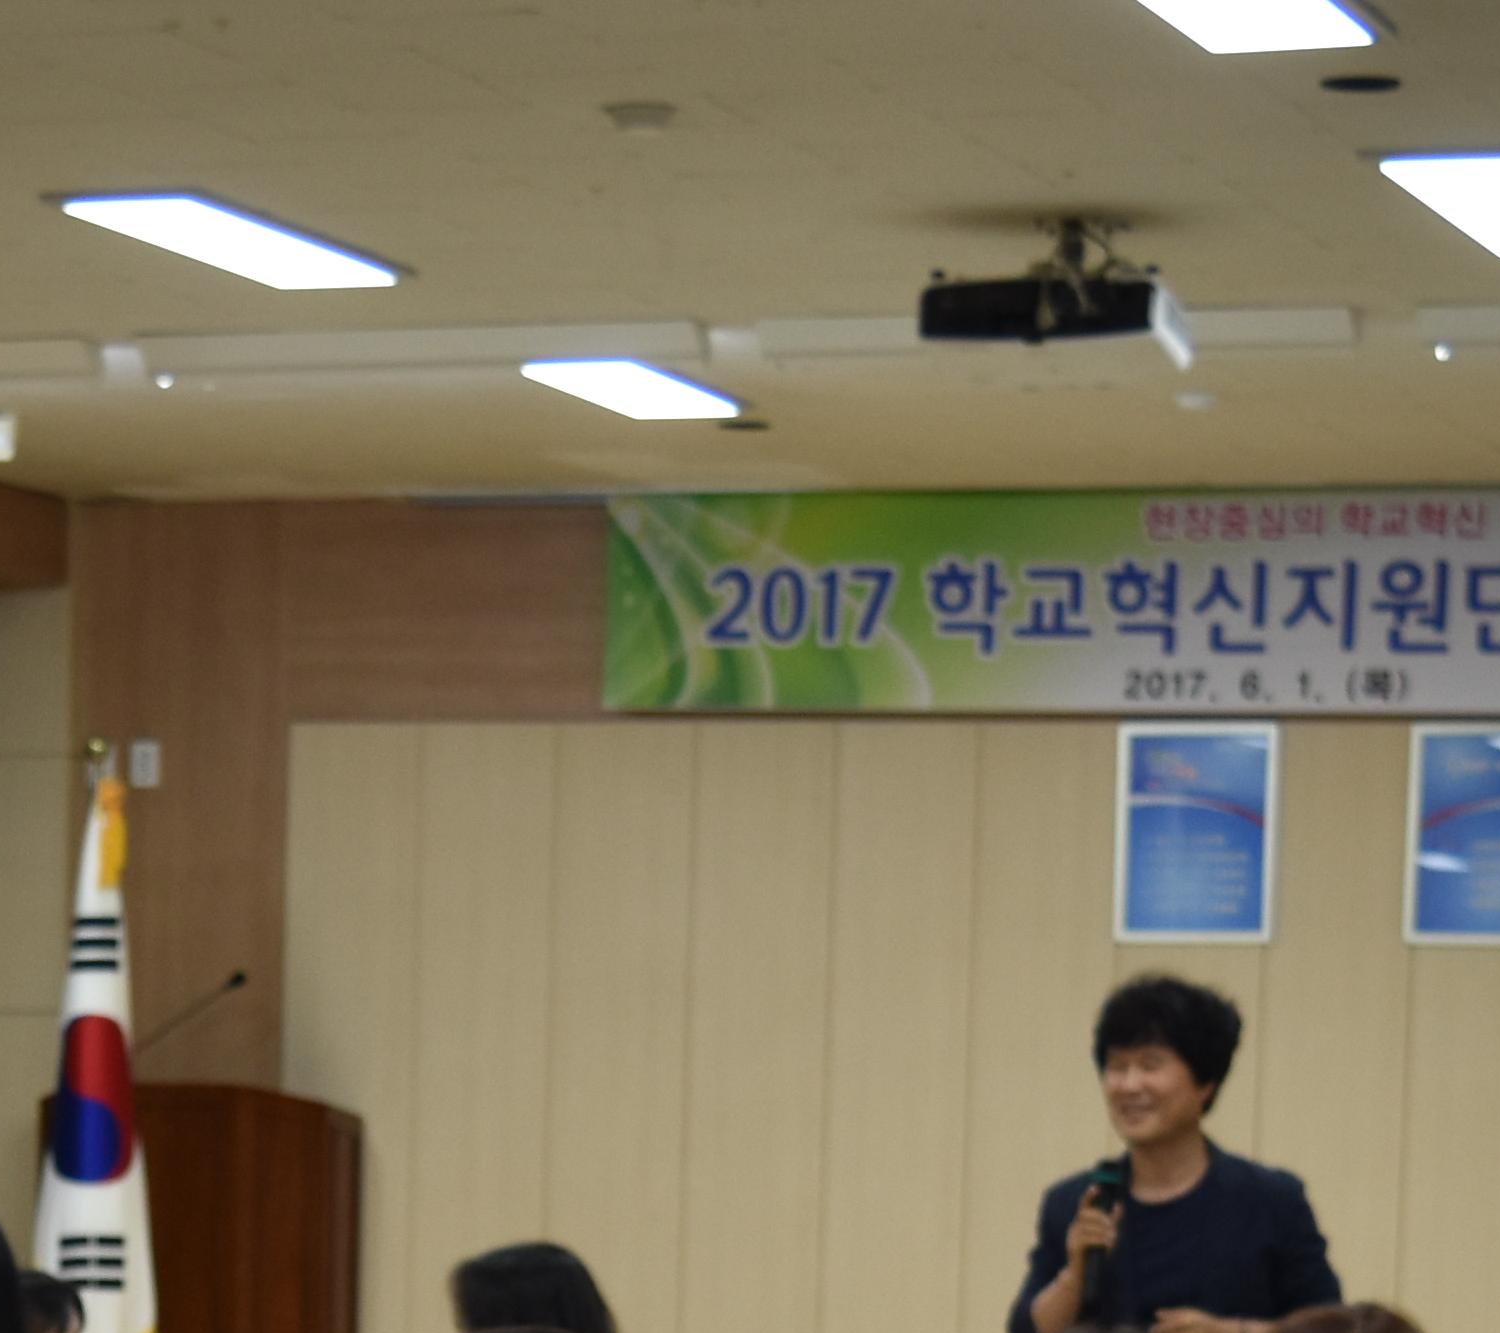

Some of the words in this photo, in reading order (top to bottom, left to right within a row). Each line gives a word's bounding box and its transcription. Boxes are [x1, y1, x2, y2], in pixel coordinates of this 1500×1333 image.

[1146, 503, 1325, 541] 현장중심의
[1341, 501, 1486, 540] 학교혁신
[705, 566, 896, 643] 2017
[1123, 670, 1217, 703] 2017.
[1297, 670, 1324, 703] 1.
